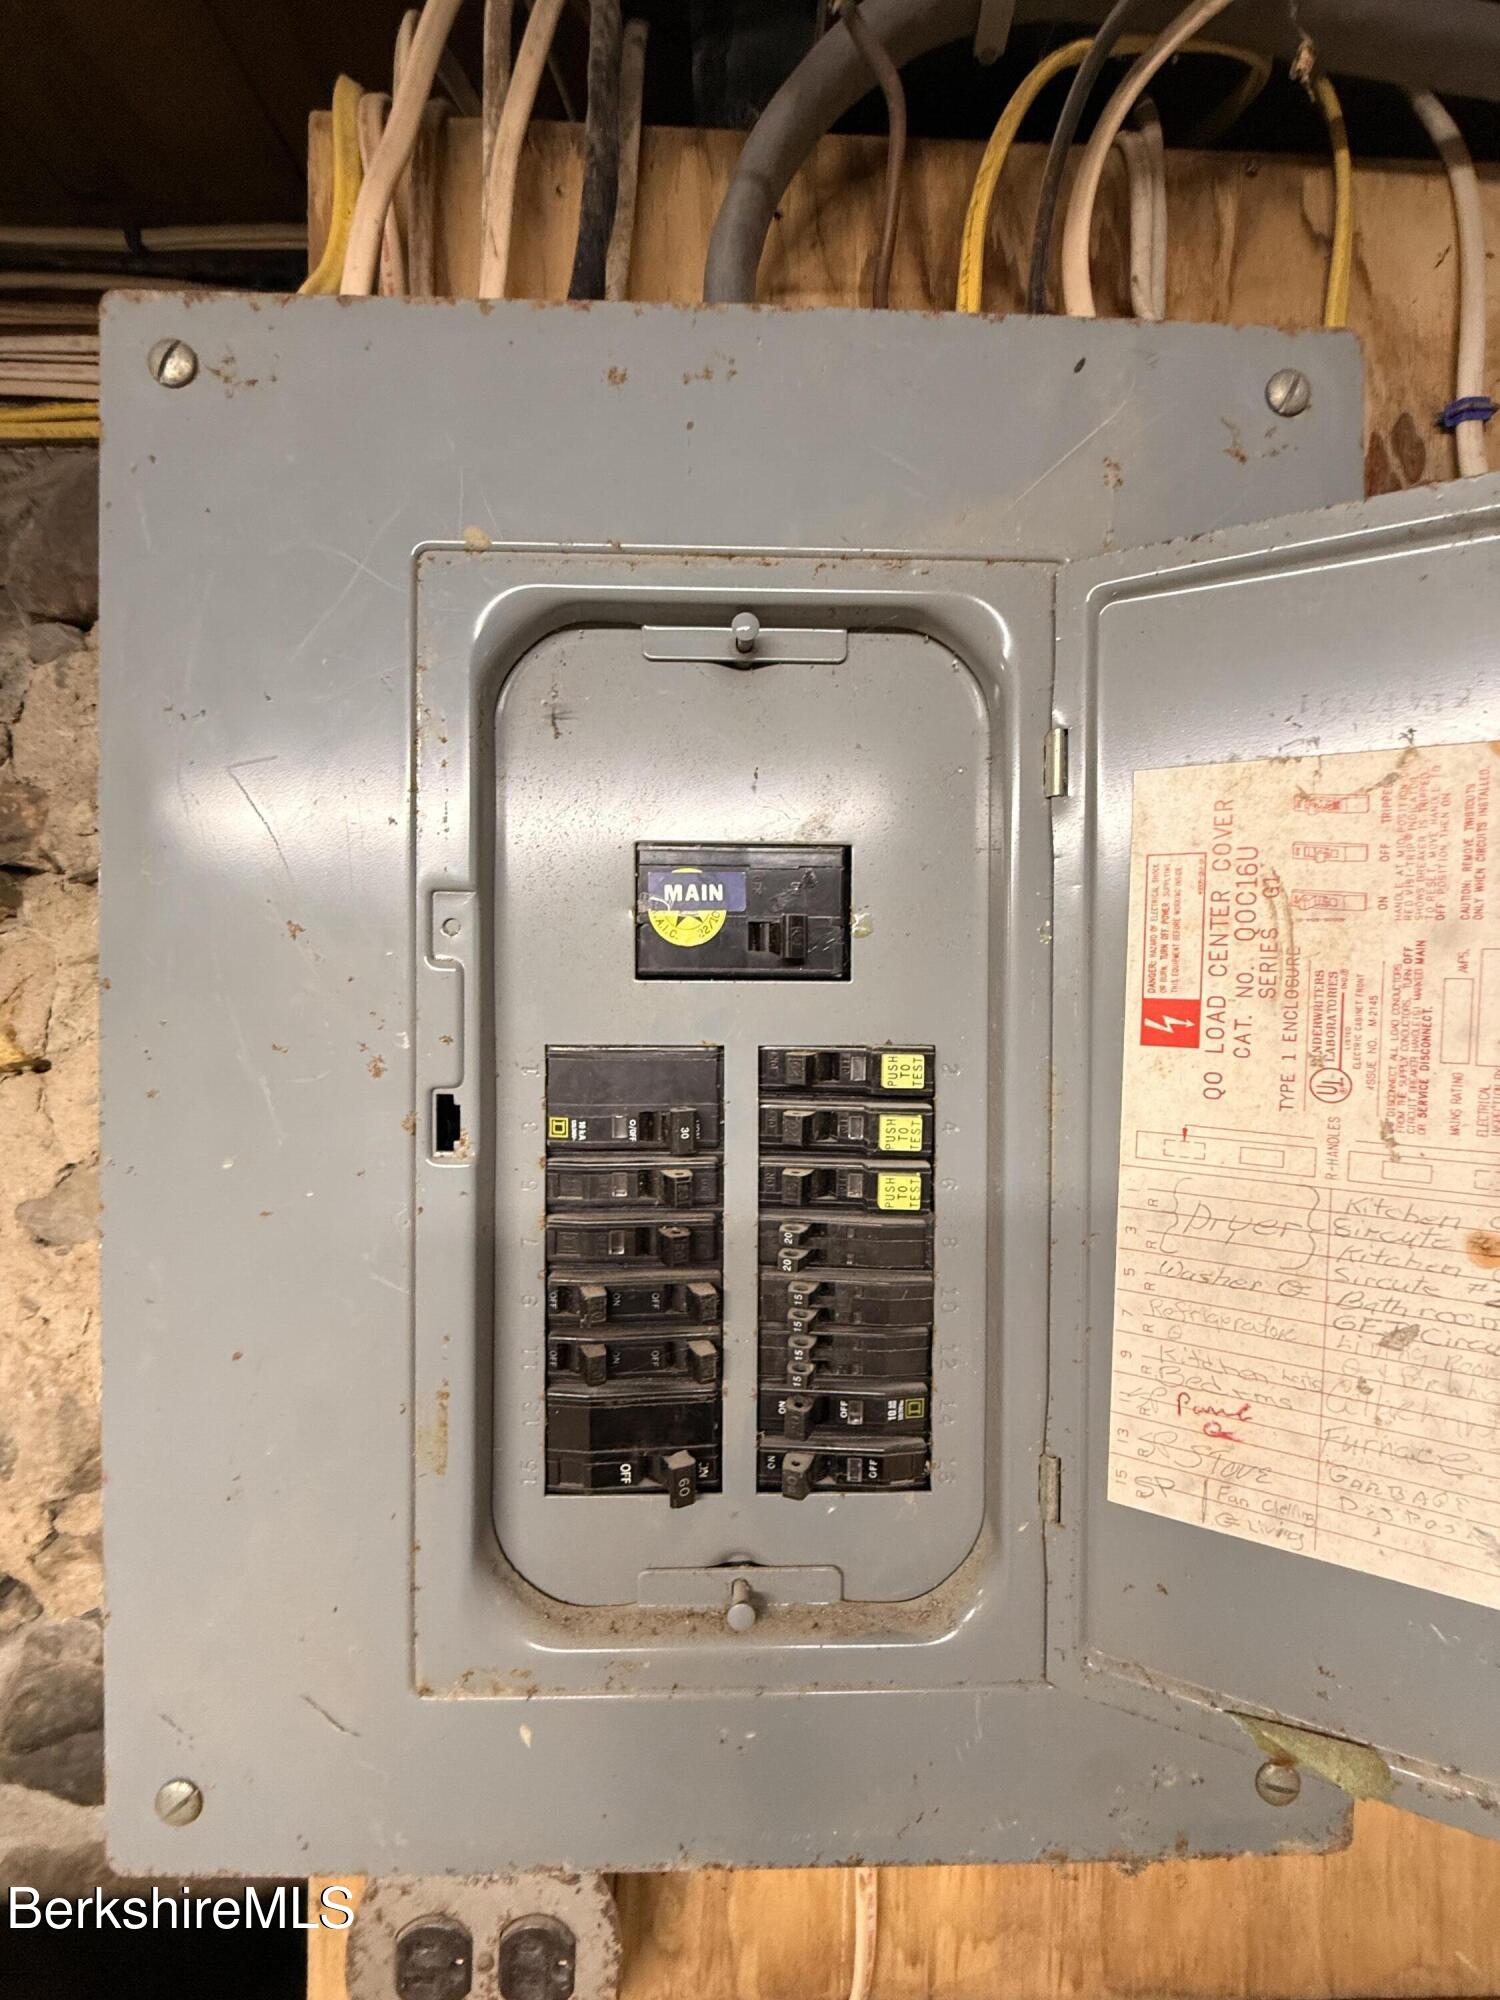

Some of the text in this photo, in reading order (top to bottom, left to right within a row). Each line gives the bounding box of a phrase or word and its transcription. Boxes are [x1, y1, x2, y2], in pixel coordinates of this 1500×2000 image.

[1476, 821, 1488, 862] CIRCUITS
[1379, 843, 1390, 862] OFF
[1462, 839, 1473, 872] REMOVE
[1474, 868, 1486, 892] WHEN
[664, 884, 723, 901] MAIN
[1160, 902, 1170, 924] POWER
[1377, 896, 1389, 911] ON
[1435, 903, 1446, 920] OFF
[1473, 897, 1485, 920] ONLY
[1160, 928, 1169, 940] OFF
[1159, 944, 1169, 960] TURN
[1203, 798, 1234, 1100] QO LOAD CENTER COVER
[1402, 946, 1414, 965] OFF
[1414, 939, 1426, 965] MAIN
[1258, 927, 1279, 999] SERIES
[1236, 966, 1255, 998] NO.
[1282, 945, 1300, 1042] ENCLOSURE
[1324, 971, 1339, 1062] LABORATORIES
[1352, 972, 1365, 1070] ELECTRIC CABINET FRONT
[1233, 1015, 1253, 1059] CAT.
[1366, 1038, 1378, 1054] NO.
[1419, 1006, 1433, 1072] DISCONNECT.
[888, 1056, 898, 1086] PUSH
[900, 1064, 910, 1078] TO
[912, 1057, 923, 1086] TEST
[1279, 1073, 1295, 1112] TYPE
[1449, 1072, 1464, 1104] RATING
[1417, 1079, 1430, 1119] SERVICE
[1475, 1085, 1491, 1138] ELECTRICAL
[680, 1127, 690, 1140] 30
[886, 1118, 896, 1150] PUSH
[898, 1127, 908, 1141] TO
[910, 1120, 921, 1149] TEST
[1324, 1116, 1341, 1180] R-HANDLES
[885, 1177, 894, 1208] PUSH
[897, 1185, 908, 1200] TO
[910, 1178, 920, 1208] TEST
[1183, 1203, 1302, 1244] Dryer
[1346, 1197, 1461, 1229] Kitchen
[784, 1232, 793, 1245] 20
[1125, 1226, 1137, 1234] 3
[783, 1259, 792, 1272] 20
[1336, 1244, 1461, 1277] Kitchen
[1123, 1267, 1135, 1276] 5
[1160, 1261, 1262, 1291] Washer
[1334, 1267, 1441, 1298] Sircute
[550, 1291, 559, 1310] OFF
[612, 1292, 621, 1306] ON
[651, 1292, 660, 1310] OFF
[794, 1293, 803, 1305] 15
[1336, 1290, 1408, 1316] Bath
[1122, 1309, 1133, 1317] 7
[793, 1320, 802, 1332] 15
[550, 1350, 559, 1368] OFF
[651, 1350, 660, 1367] OFF
[794, 1349, 803, 1361] 15
[1120, 1350, 1132, 1359] 9
[793, 1376, 802, 1387] 15
[1156, 1365, 1222, 1390] Bed
[778, 1400, 787, 1415] ON
[840, 1401, 849, 1418] OFF
[1117, 1428, 1129, 1443] 13
[767, 1455, 776, 1470] ON
[868, 1459, 878, 1479] OFF
[619, 1463, 632, 1485] OFF
[1115, 1469, 1128, 1485] 15
[678, 1477, 690, 1497] 60
[1216, 1486, 1249, 1508] Fan
